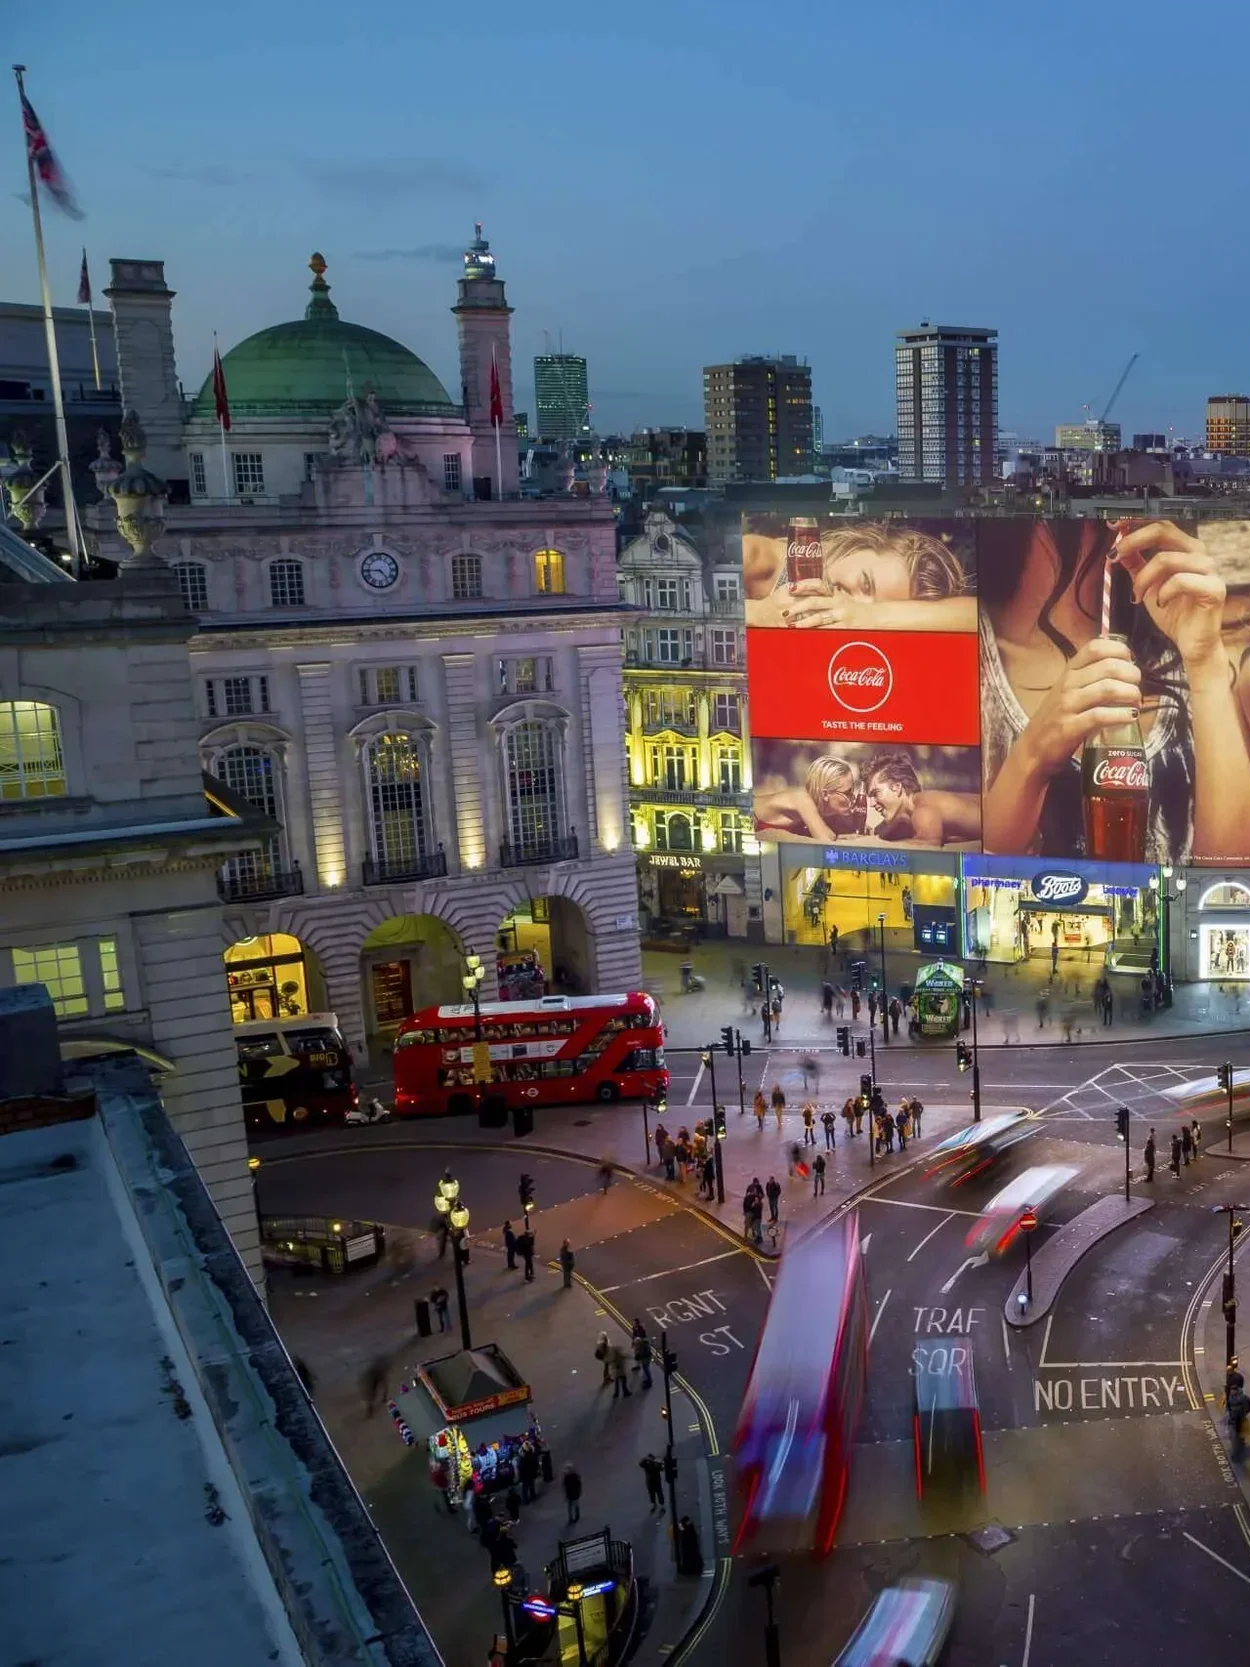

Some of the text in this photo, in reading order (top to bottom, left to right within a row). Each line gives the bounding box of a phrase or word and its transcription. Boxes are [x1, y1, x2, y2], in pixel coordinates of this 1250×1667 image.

[834, 667, 885, 687] Coca-Cola
[822, 720, 903, 731] TASTE THE FEELING
[649, 855, 701, 868] JEWEL BAR
[842, 852, 907, 867] BARCLAYS
[971, 877, 1023, 890] pharmacy
[1036, 875, 1082, 900] Boots
[646, 1289, 727, 1328] RGNT
[913, 1306, 986, 1333] TRAF
[699, 1325, 745, 1355] ST
[908, 1348, 967, 1376] SQR
[1034, 1376, 1178, 1411] NO ENTRY
[1212, 1443, 1229, 1465] BOTH
[1221, 1467, 1238, 1489] LOOK
